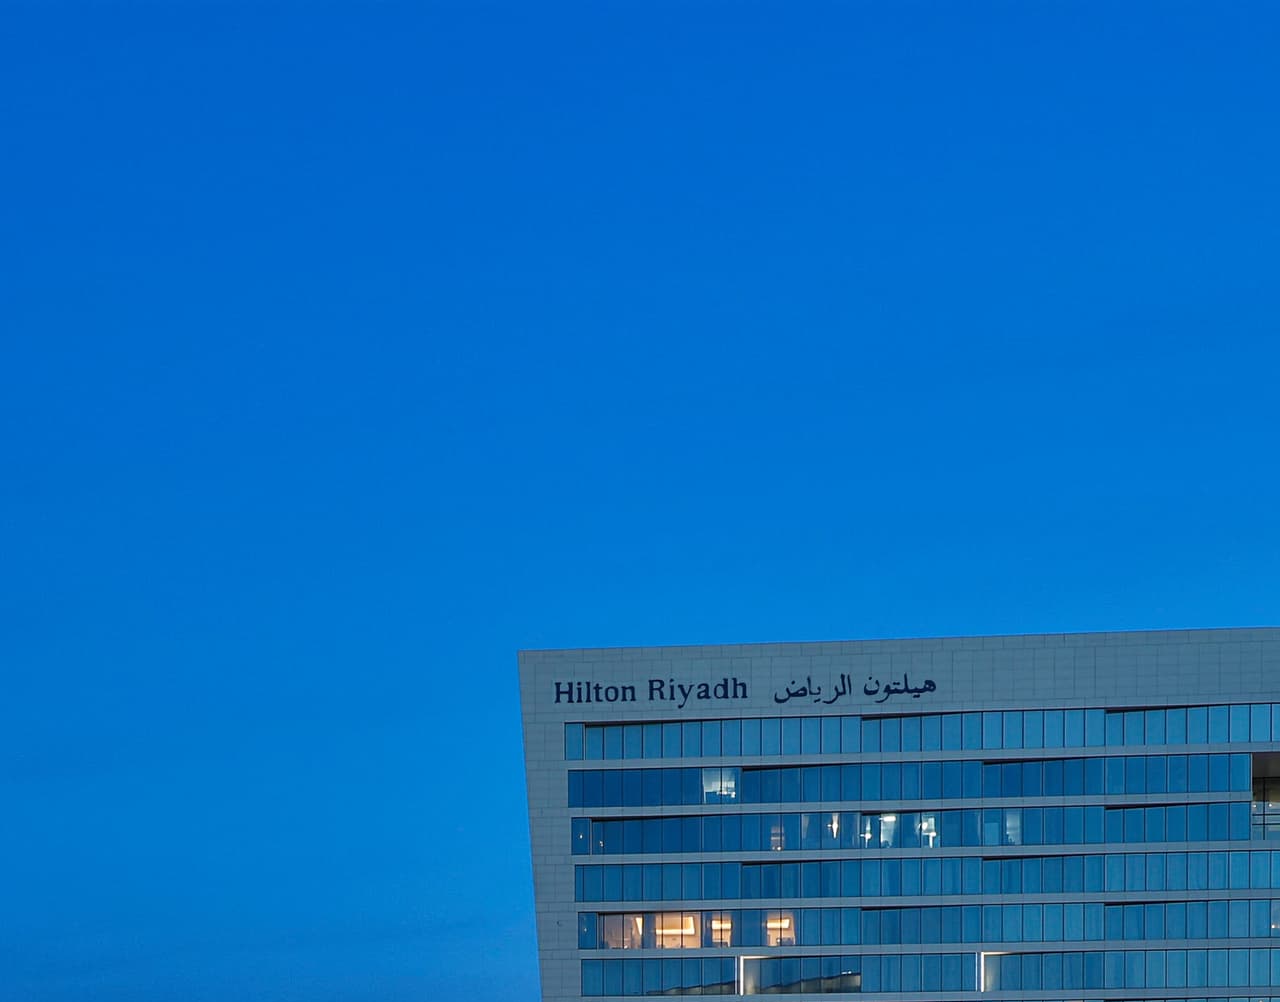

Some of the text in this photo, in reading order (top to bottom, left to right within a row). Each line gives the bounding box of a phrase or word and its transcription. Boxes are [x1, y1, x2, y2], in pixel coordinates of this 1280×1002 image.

[554, 678, 749, 709] Hilton Riyadh
[773, 672, 937, 706] هيلتون الرياض
